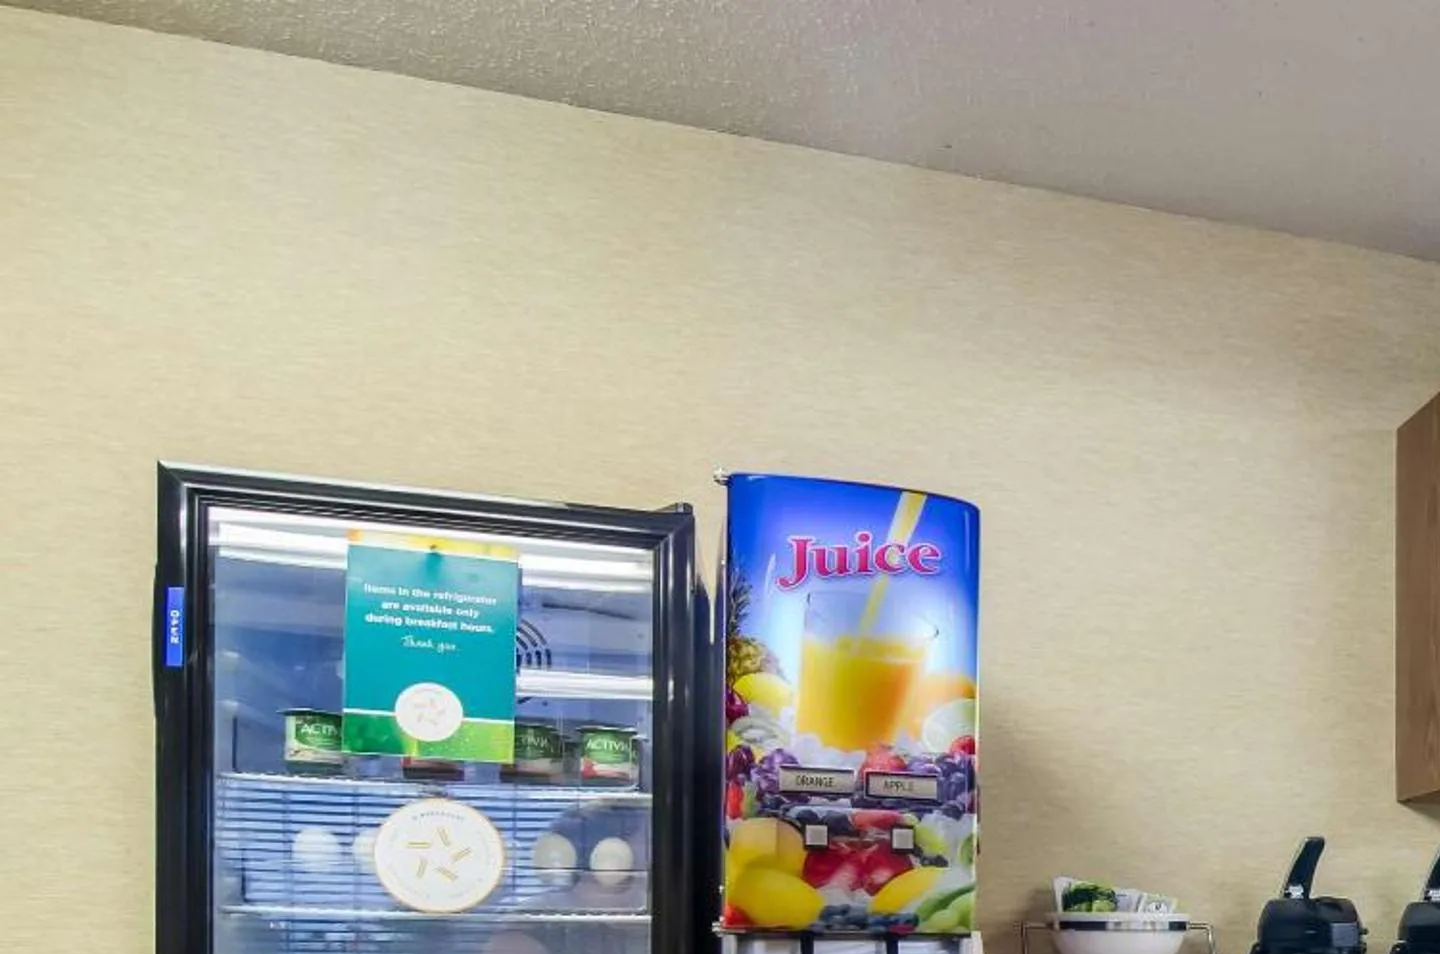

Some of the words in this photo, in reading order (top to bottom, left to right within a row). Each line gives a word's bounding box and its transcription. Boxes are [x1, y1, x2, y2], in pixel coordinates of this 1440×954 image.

[776, 531, 942, 591] Juice
[411, 588, 431, 599] the
[381, 601, 400, 610] are
[456, 608, 479, 619] only
[364, 612, 403, 626] during
